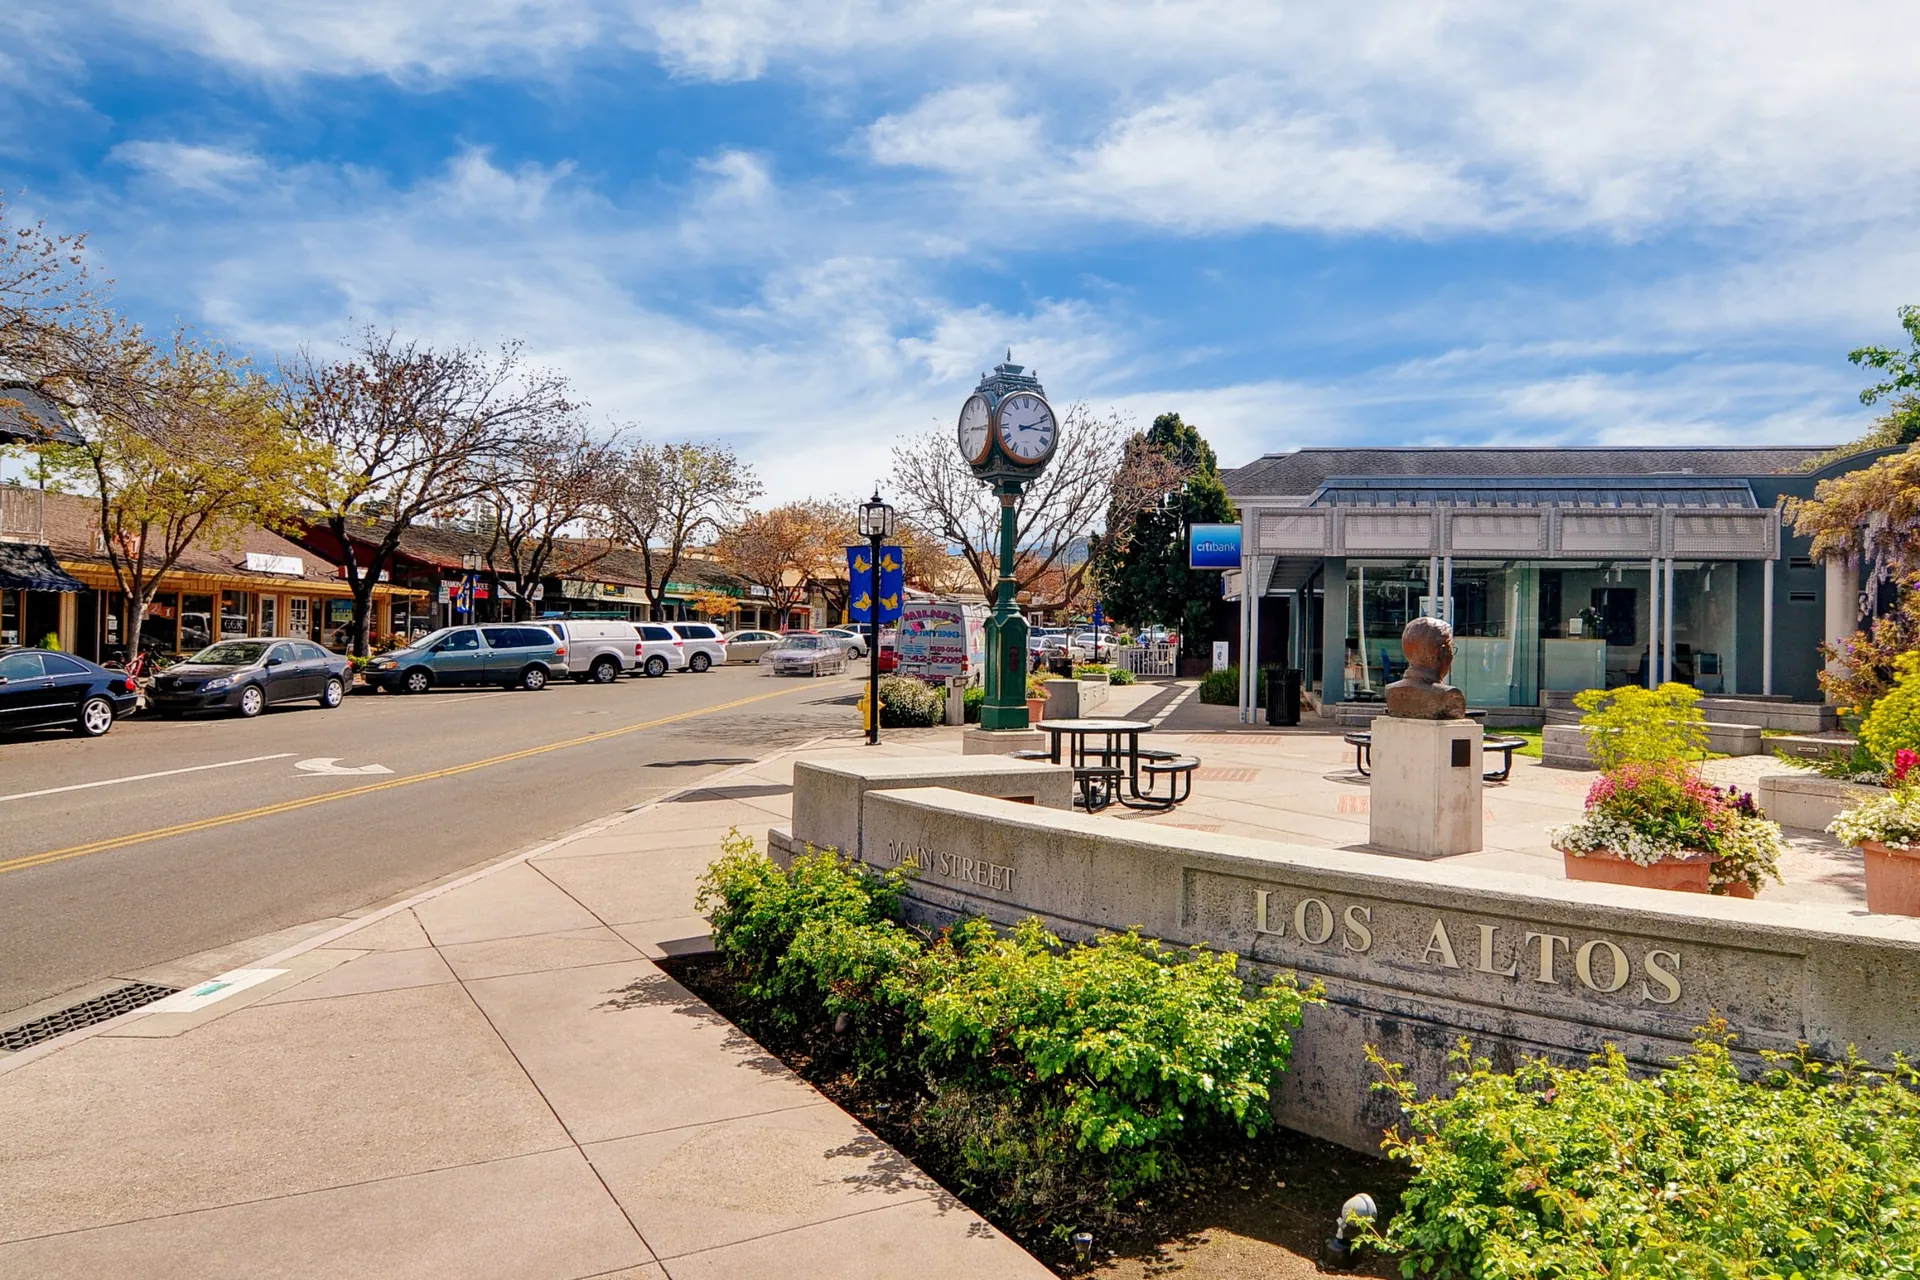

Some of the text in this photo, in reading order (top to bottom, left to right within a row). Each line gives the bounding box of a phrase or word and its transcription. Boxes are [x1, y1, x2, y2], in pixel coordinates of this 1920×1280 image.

[1196, 541, 1236, 552] citibank
[889, 839, 1016, 892] MAIN STREET
[1253, 889, 1682, 1004] LOS ALTOS
